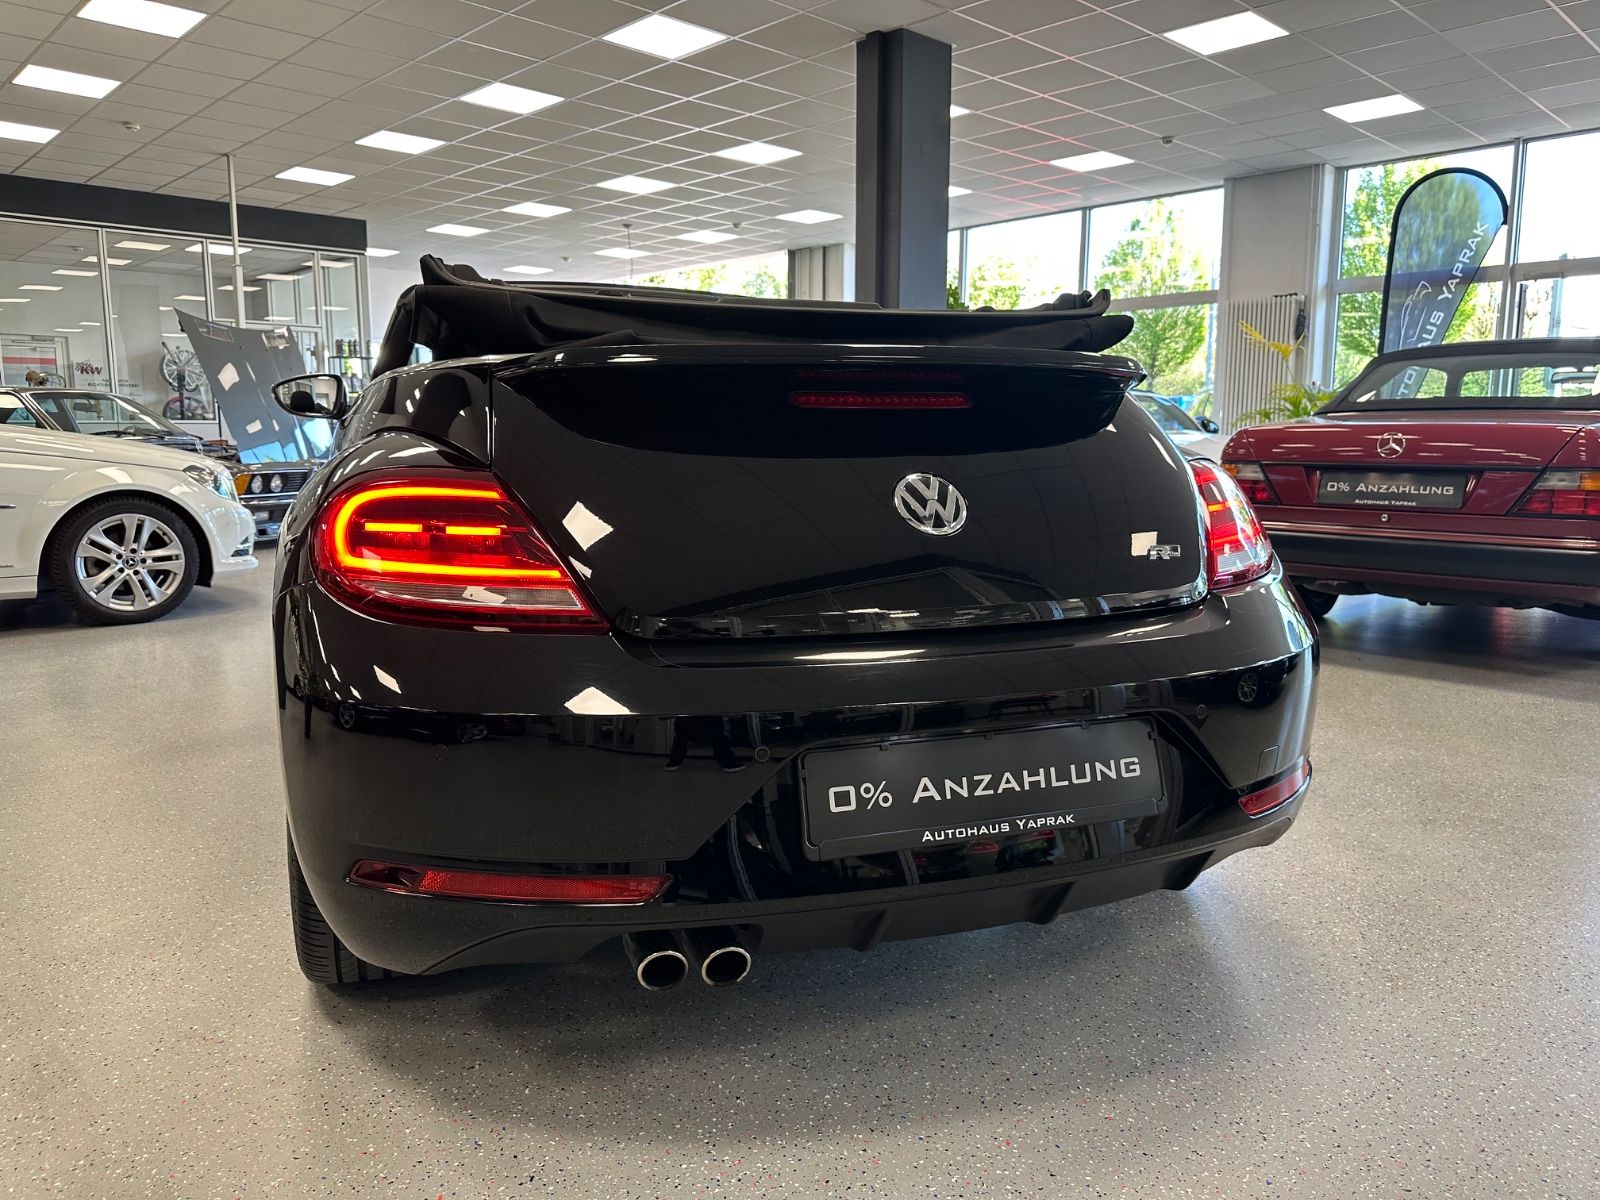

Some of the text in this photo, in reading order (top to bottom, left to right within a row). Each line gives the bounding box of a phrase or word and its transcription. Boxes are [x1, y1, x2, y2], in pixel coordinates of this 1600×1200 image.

[1437, 221, 1490, 300] YAPRAK
[1326, 482, 1454, 495] 0% ANZAHLUNG
[828, 756, 1141, 813] 0% ANZAHLUNG
[921, 814, 1075, 842] AUTOHAUS YAPRAK
